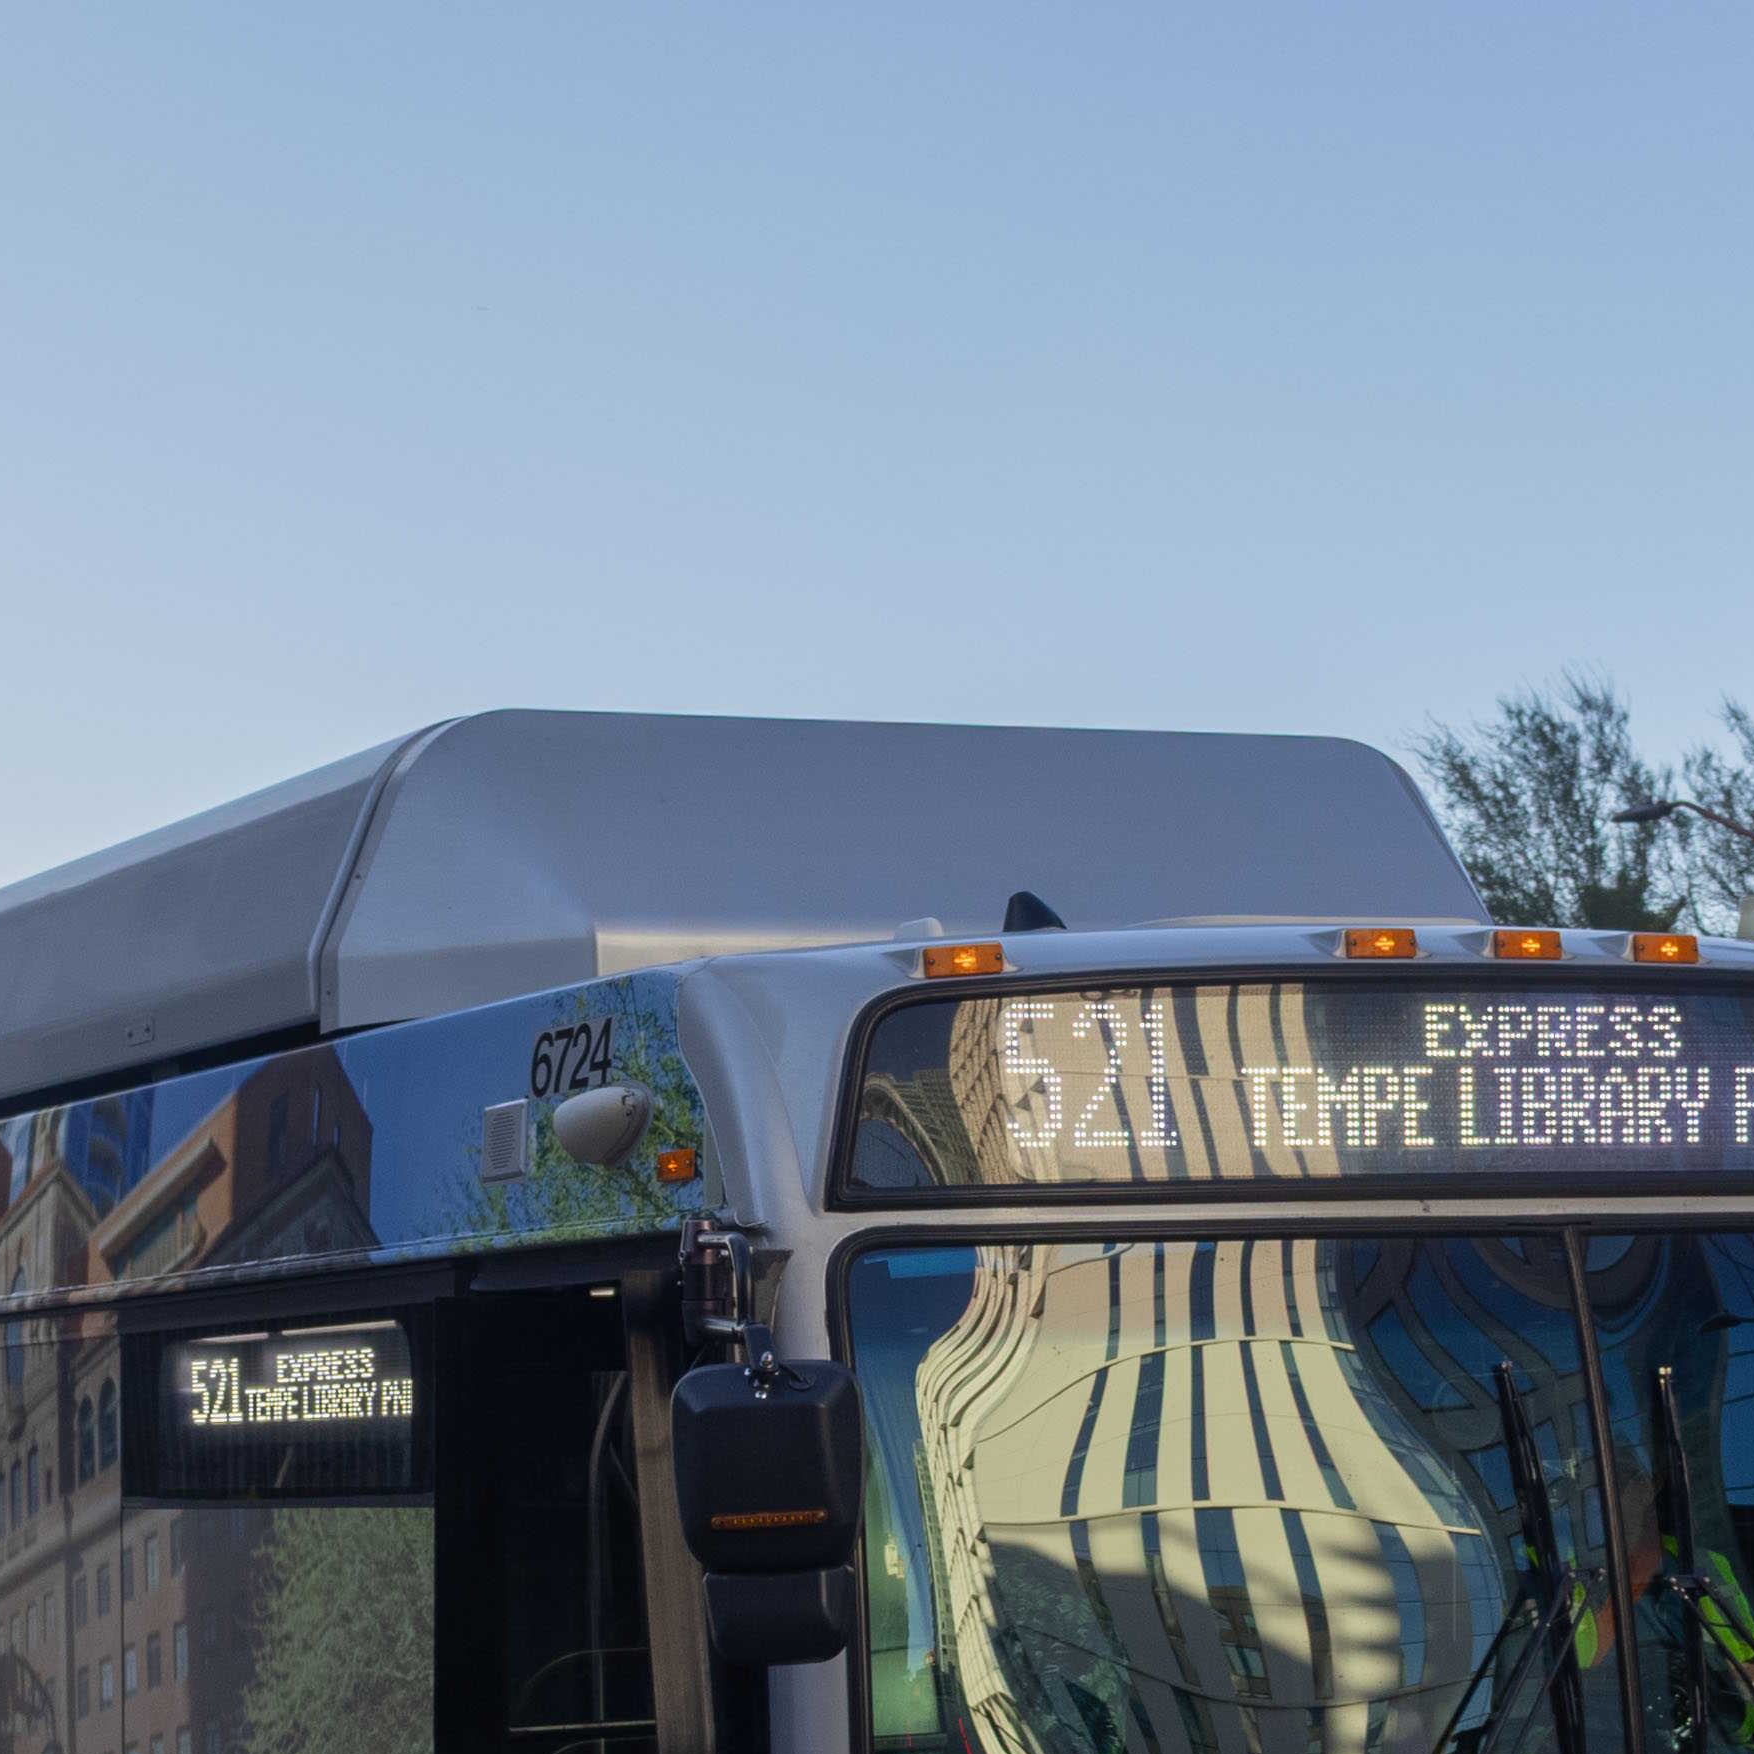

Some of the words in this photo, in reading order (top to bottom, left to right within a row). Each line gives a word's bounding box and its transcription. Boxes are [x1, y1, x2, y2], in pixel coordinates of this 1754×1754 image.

[531, 1017, 612, 1098] 6724
[1425, 1004, 1682, 1057] EXPRESS
[1005, 1003, 1178, 1148] 521
[1241, 1067, 1435, 1146] TEMPE
[1460, 1066, 1710, 1145] LIBRARY
[191, 1358, 243, 1424] 521
[245, 1386, 298, 1421] TEMPE
[302, 1381, 378, 1420] LIBRARY
[276, 1348, 375, 1383] EXPRESS
